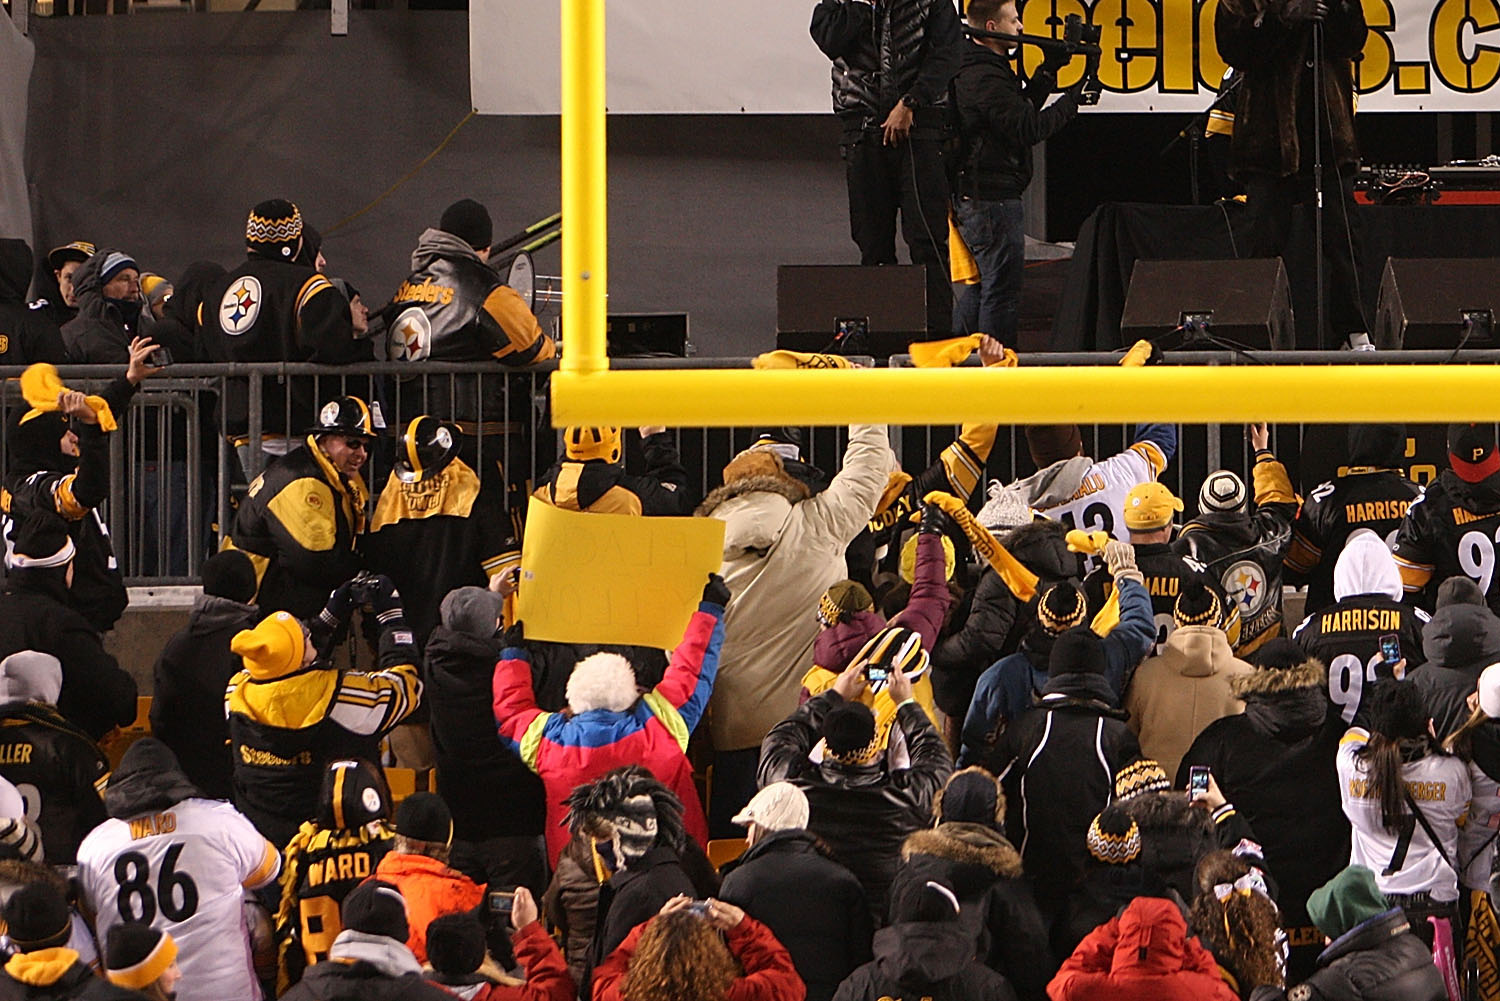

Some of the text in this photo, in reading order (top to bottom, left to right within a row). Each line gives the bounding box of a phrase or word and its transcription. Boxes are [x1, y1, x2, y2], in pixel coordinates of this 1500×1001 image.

[1473, 447, 1484, 461] P
[1346, 500, 1410, 524] HARRISO
[1321, 610, 1402, 634] HARRISON
[129, 812, 177, 841] WARD
[308, 851, 371, 888] WARD
[114, 842, 200, 930] 86
